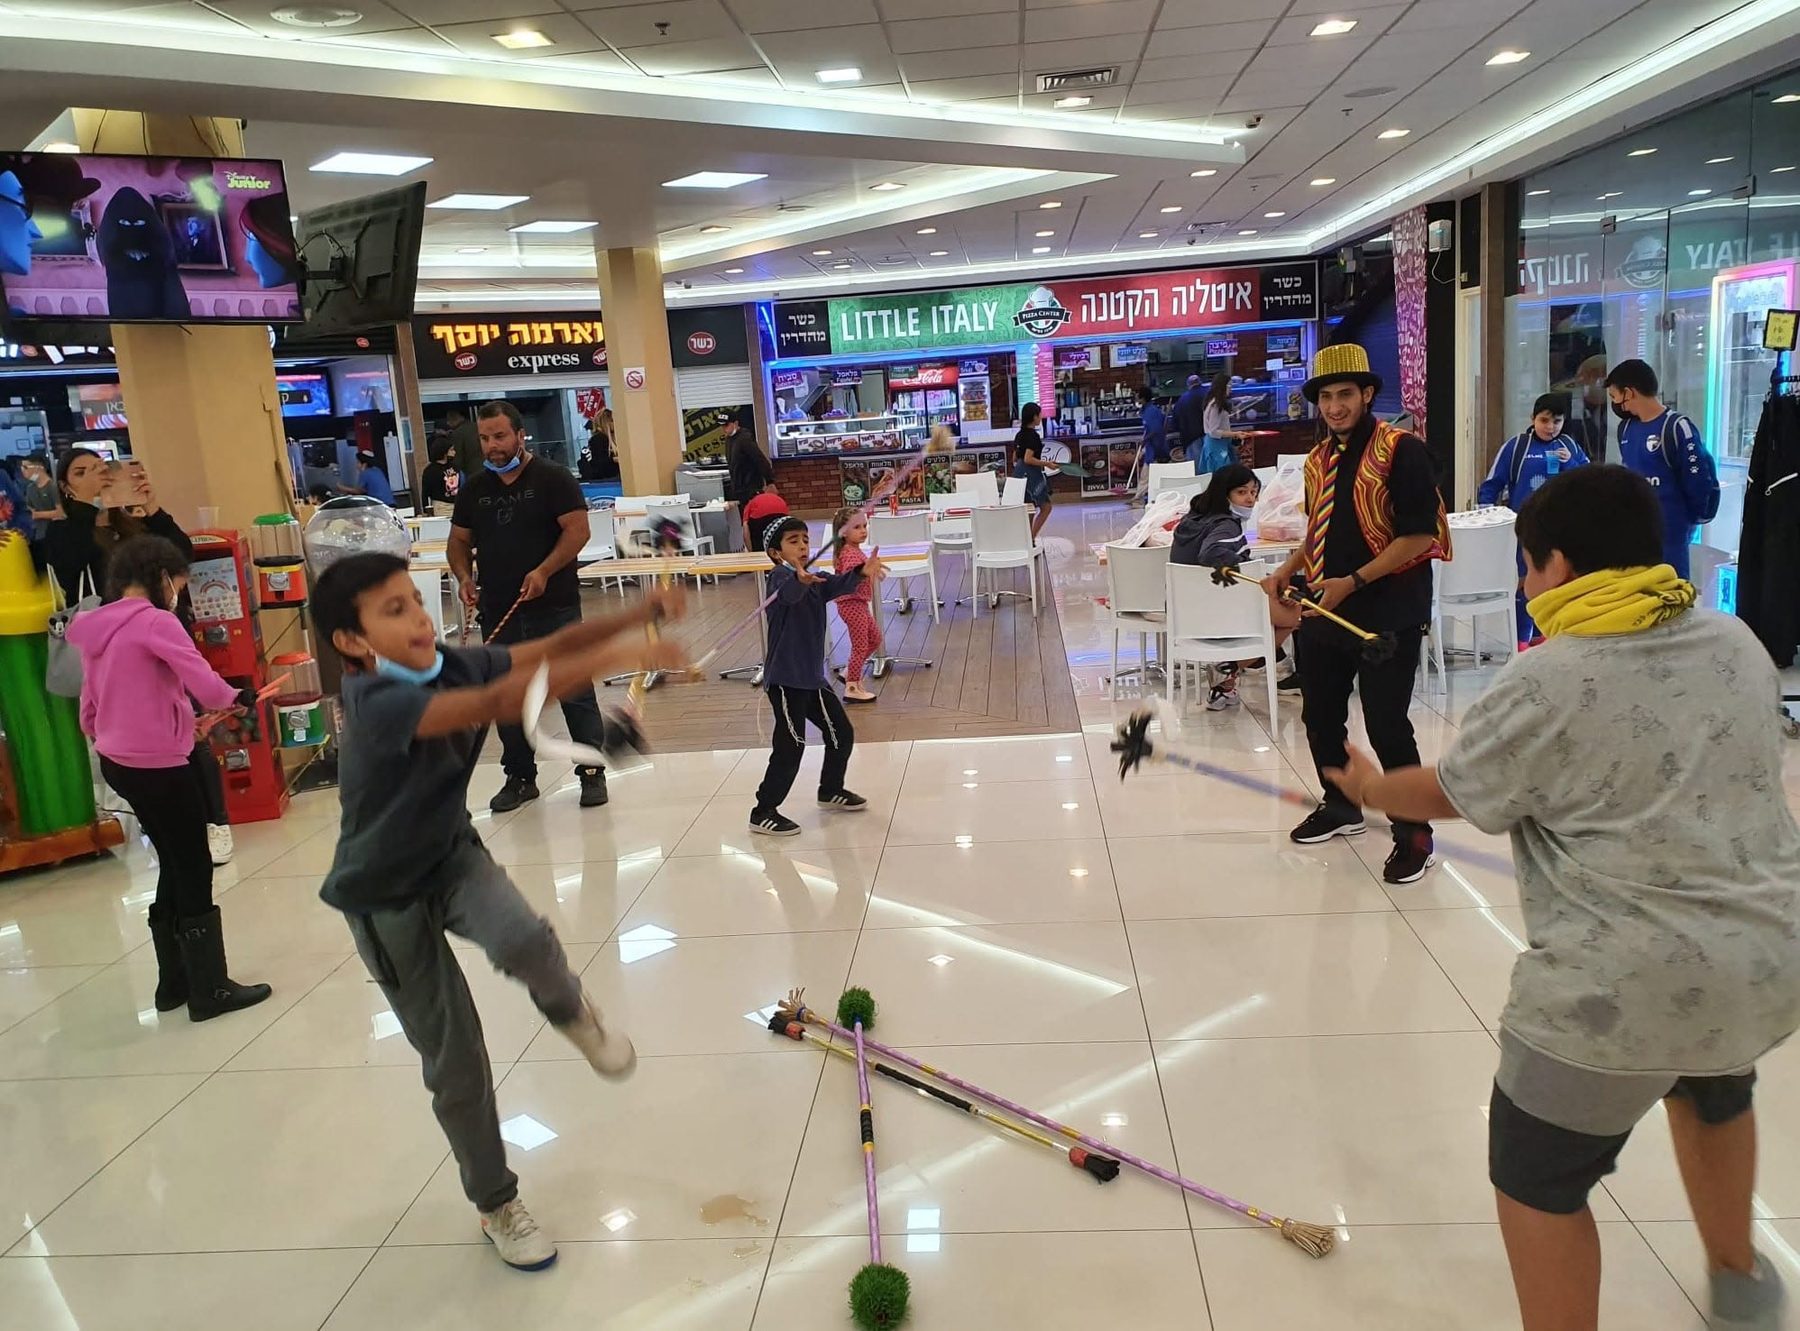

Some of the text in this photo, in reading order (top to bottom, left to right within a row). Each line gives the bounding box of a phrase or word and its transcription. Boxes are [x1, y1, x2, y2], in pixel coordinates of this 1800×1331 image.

[1273, 276, 1302, 289] כשר
[1081, 278, 1252, 328] איטליה הקטנה
[1263, 293, 1312, 311] מהדרין
[788, 313, 816, 326] כשר
[841, 301, 999, 342] LITTLE ITALY
[431, 321, 604, 354] וארמה יוסף
[690, 337, 714, 349] כשר
[780, 330, 827, 347] מהדרין
[456, 356, 476, 367] כשר
[507, 352, 580, 374] express
